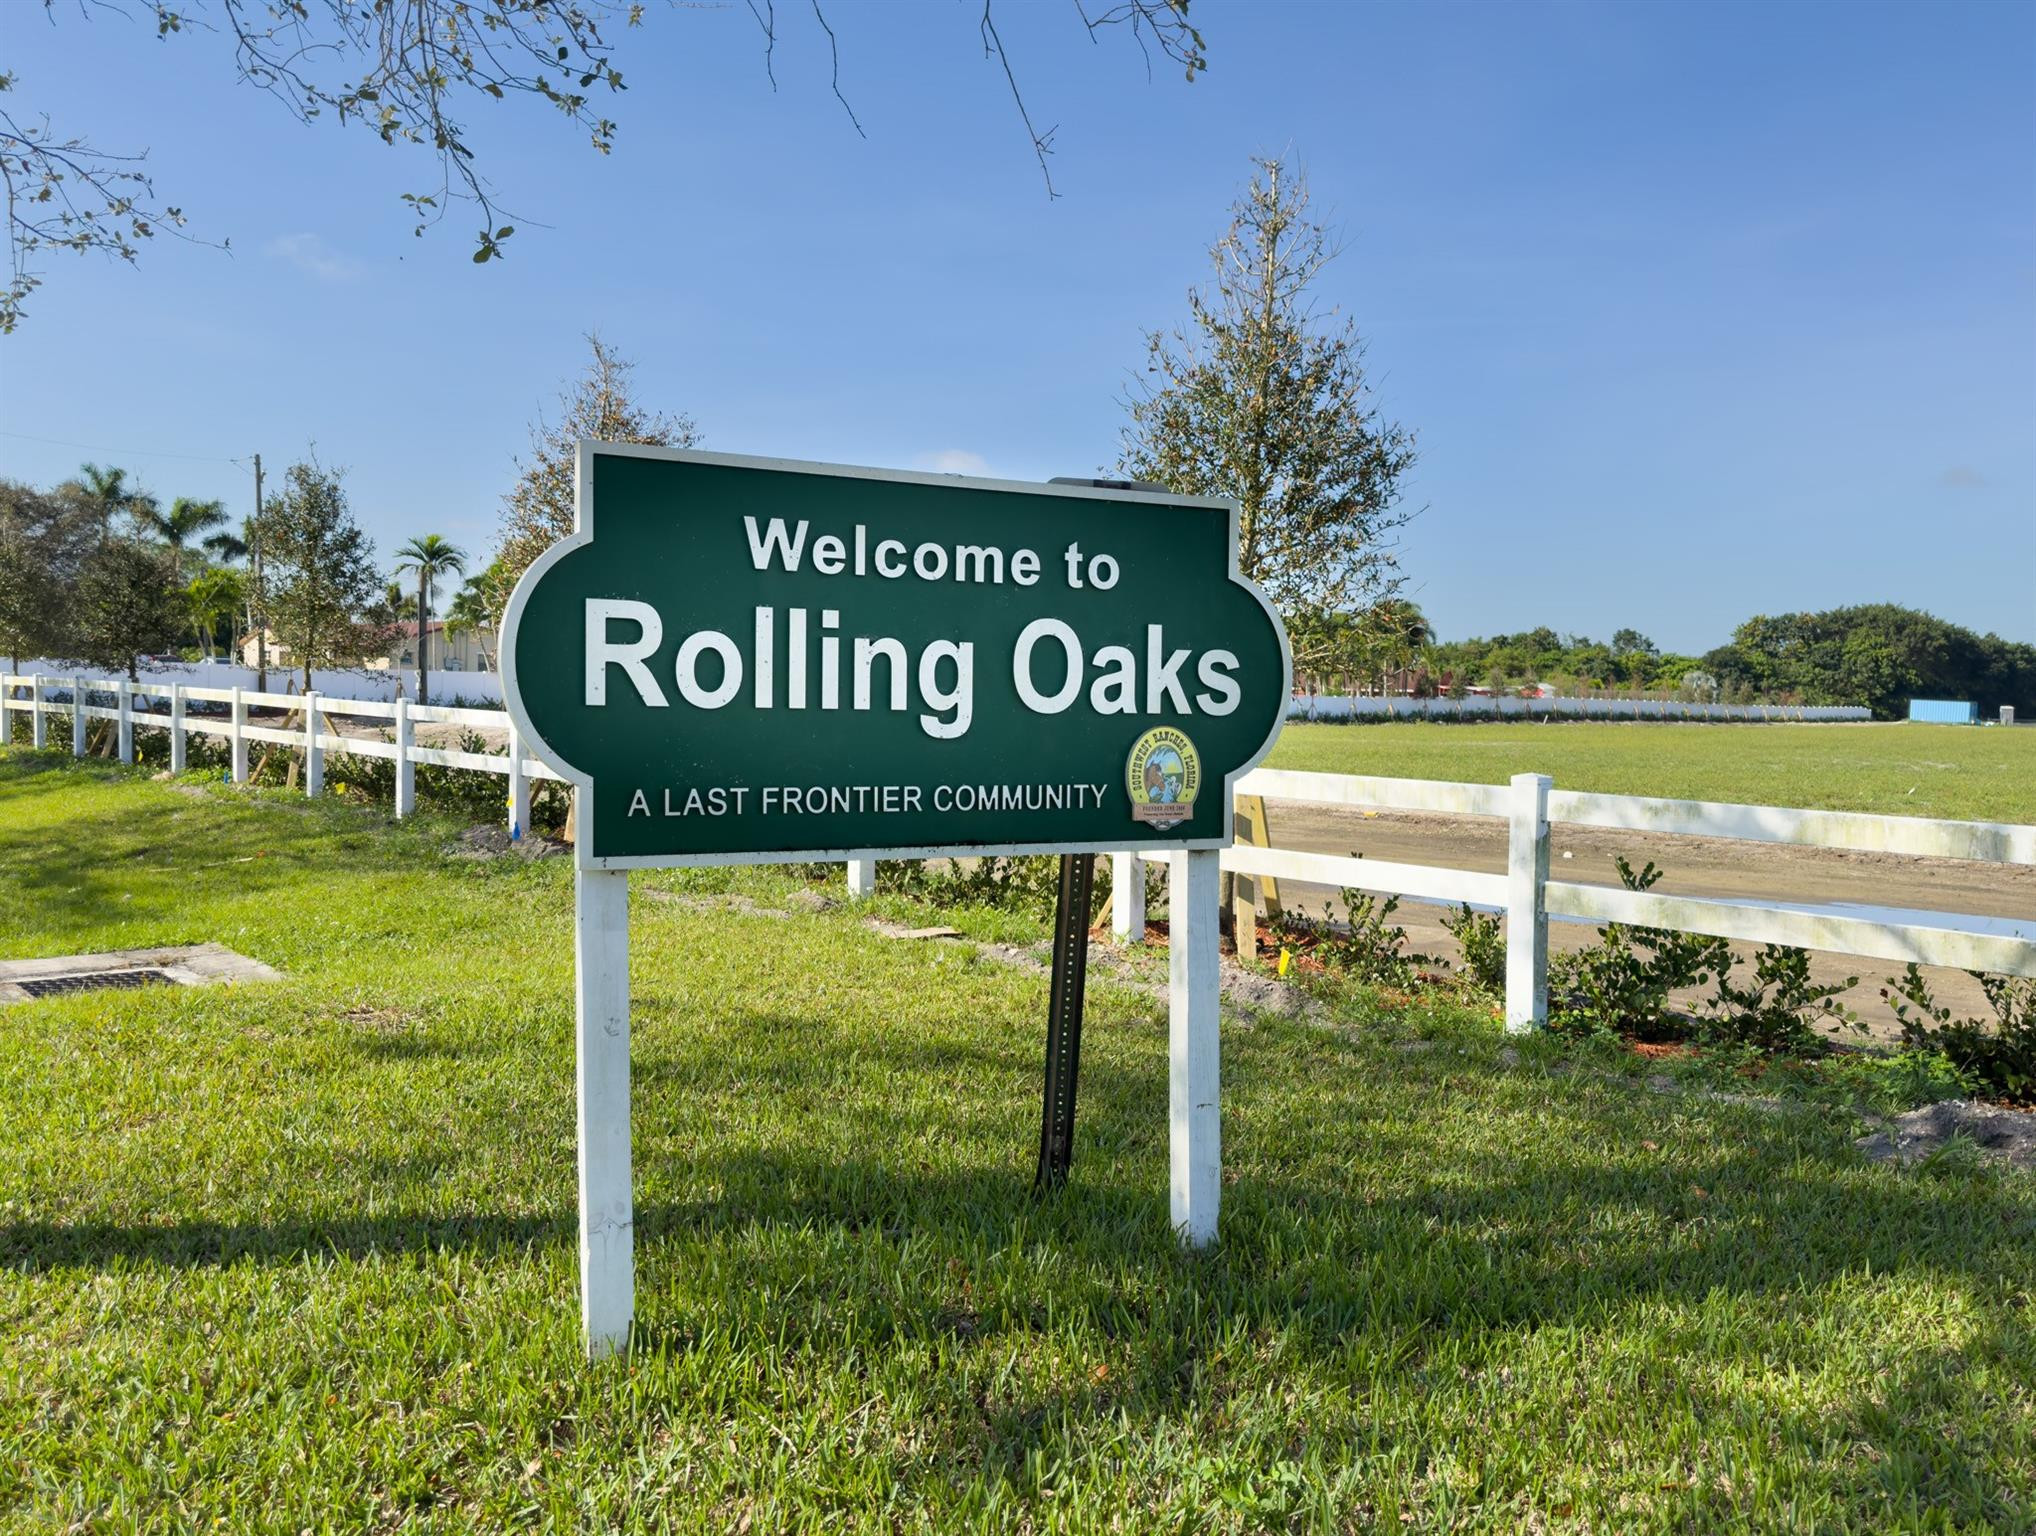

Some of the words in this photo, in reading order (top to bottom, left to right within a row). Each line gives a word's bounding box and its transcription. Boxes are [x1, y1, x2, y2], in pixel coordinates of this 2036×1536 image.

[743, 515, 1041, 587] Welcome
[1064, 542, 1121, 591] to
[584, 597, 974, 740] Rolling
[1012, 617, 1241, 717] Oaks
[628, 789, 652, 818] A
[664, 787, 750, 816] LAST
[762, 785, 923, 814] FRONTIER
[933, 784, 1108, 812] COMMUNITY
